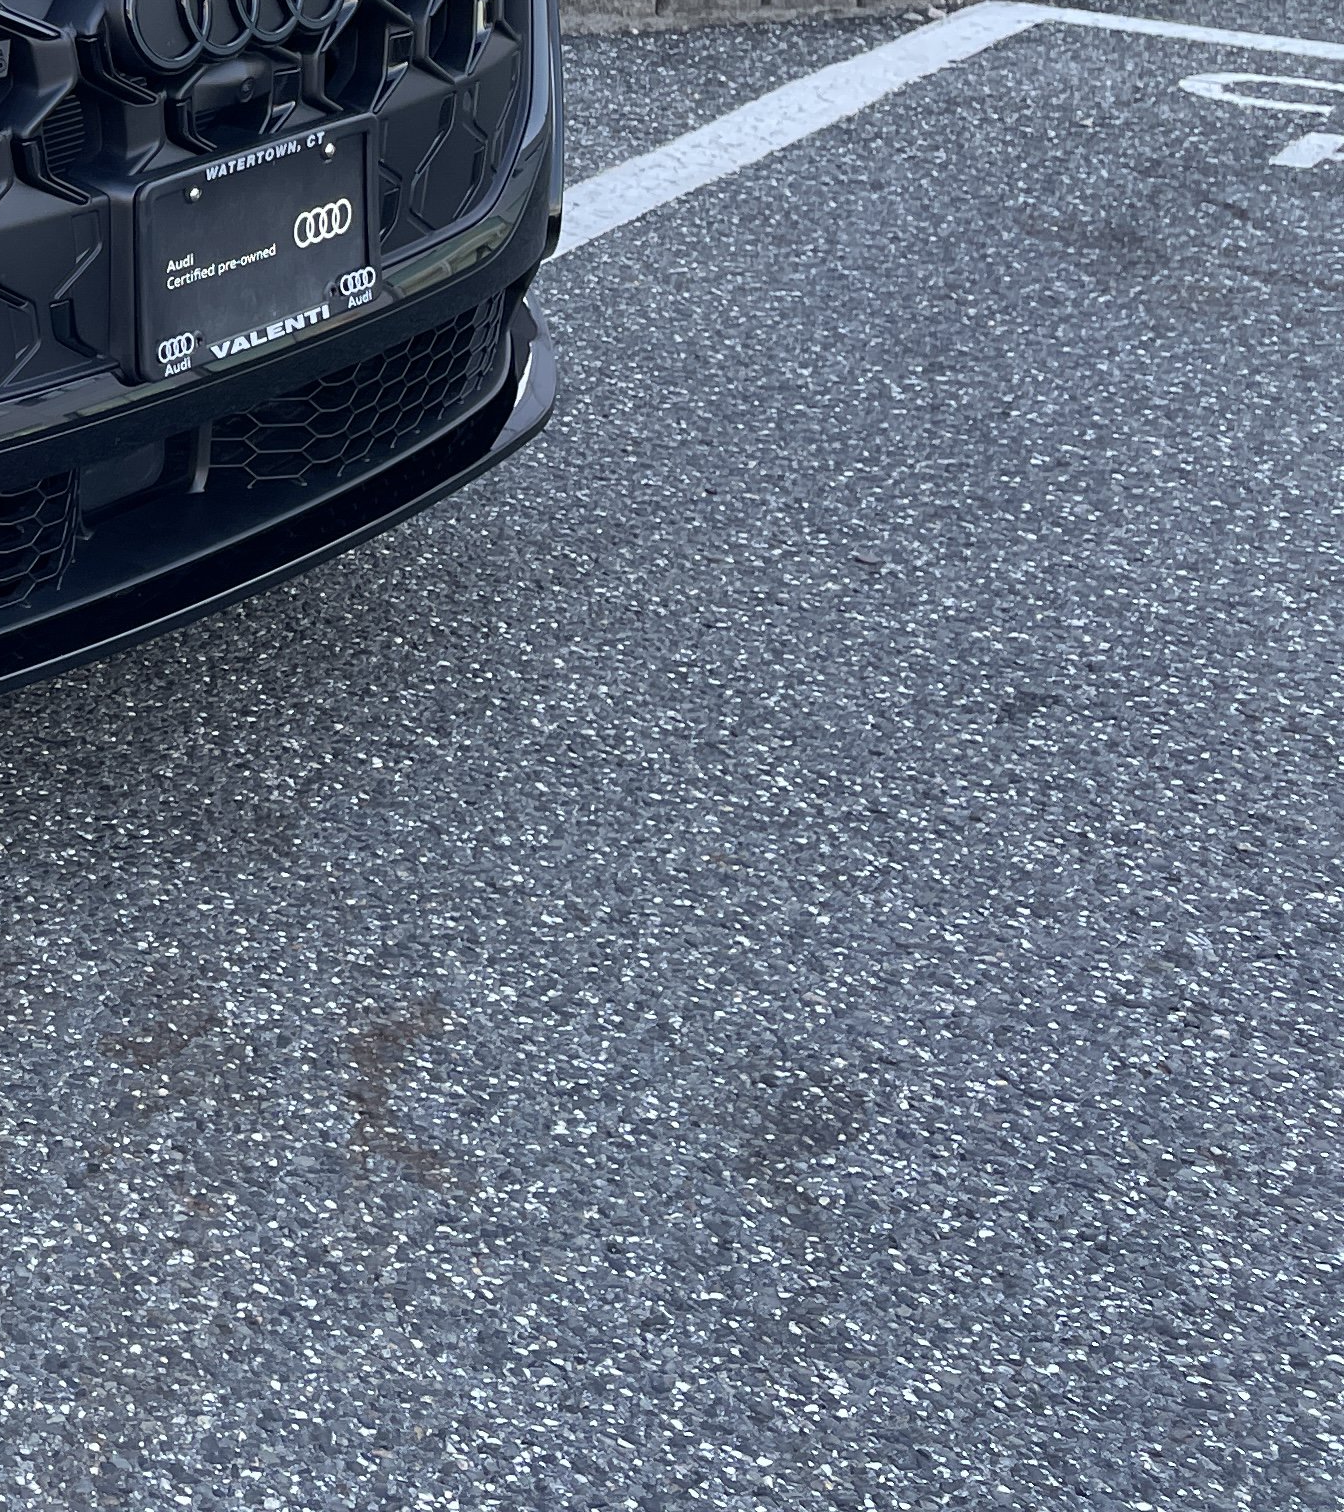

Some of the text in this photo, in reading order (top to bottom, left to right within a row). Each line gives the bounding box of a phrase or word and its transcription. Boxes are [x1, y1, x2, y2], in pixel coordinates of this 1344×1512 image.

[205, 131, 326, 181] WATERTOWN, CT
[166, 253, 194, 274] Audi
[167, 243, 277, 290] Certified pre-owned
[347, 290, 373, 309] Audi
[209, 304, 330, 359] VALENTI
[164, 357, 192, 378] Audi
